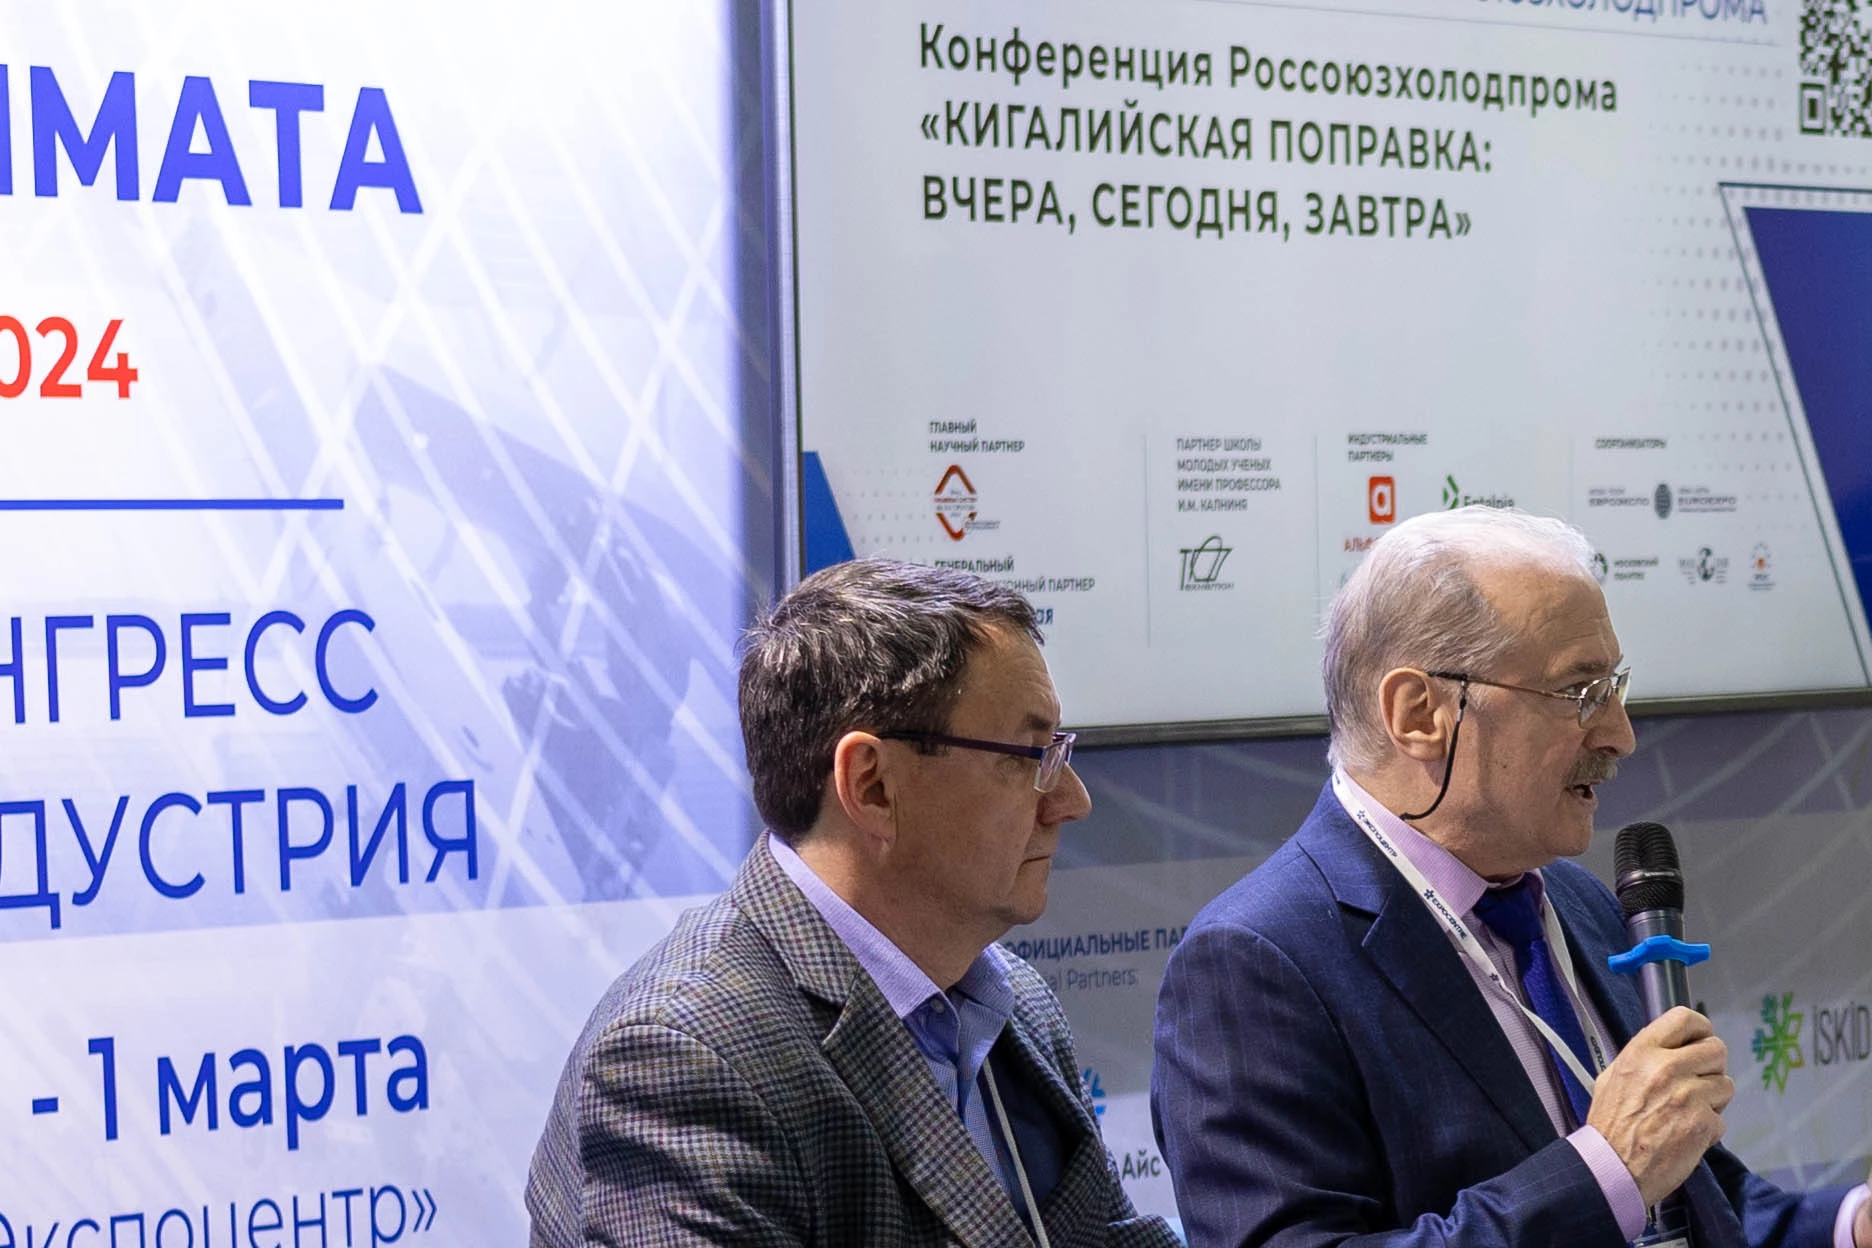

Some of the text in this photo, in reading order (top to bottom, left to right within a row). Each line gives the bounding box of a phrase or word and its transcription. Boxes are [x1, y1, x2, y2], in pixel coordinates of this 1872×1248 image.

[920, 23, 1618, 117] Конференция Россоюзхолодпрома
[0, 63, 424, 214] МАТА
[920, 99, 1492, 173] «КИГАЛИЙСКАЯ ПОПРАВКА:
[922, 174, 1472, 242] ВЧЕРА, СЕГОДНЯ, ЗАВТРА»
[929, 418, 977, 434] ГЛАВНЫЙ
[930, 438, 1025, 453] НАУЧНЫЙ ПАРТНЕР
[1176, 437, 1262, 452] ПАРТНЕР ШКОЛЫ
[1177, 458, 1229, 473] МОЛОДЫХ
[1215, 478, 1281, 491] ПРОФЕССОРА
[1048, 577, 1096, 592] ПАРТНЕР
[1066, 968, 1138, 990] Partners
[87, 1036, 119, 1141] 1
[156, 1032, 431, 1151] марта
[1121, 1150, 1162, 1181] Айс
